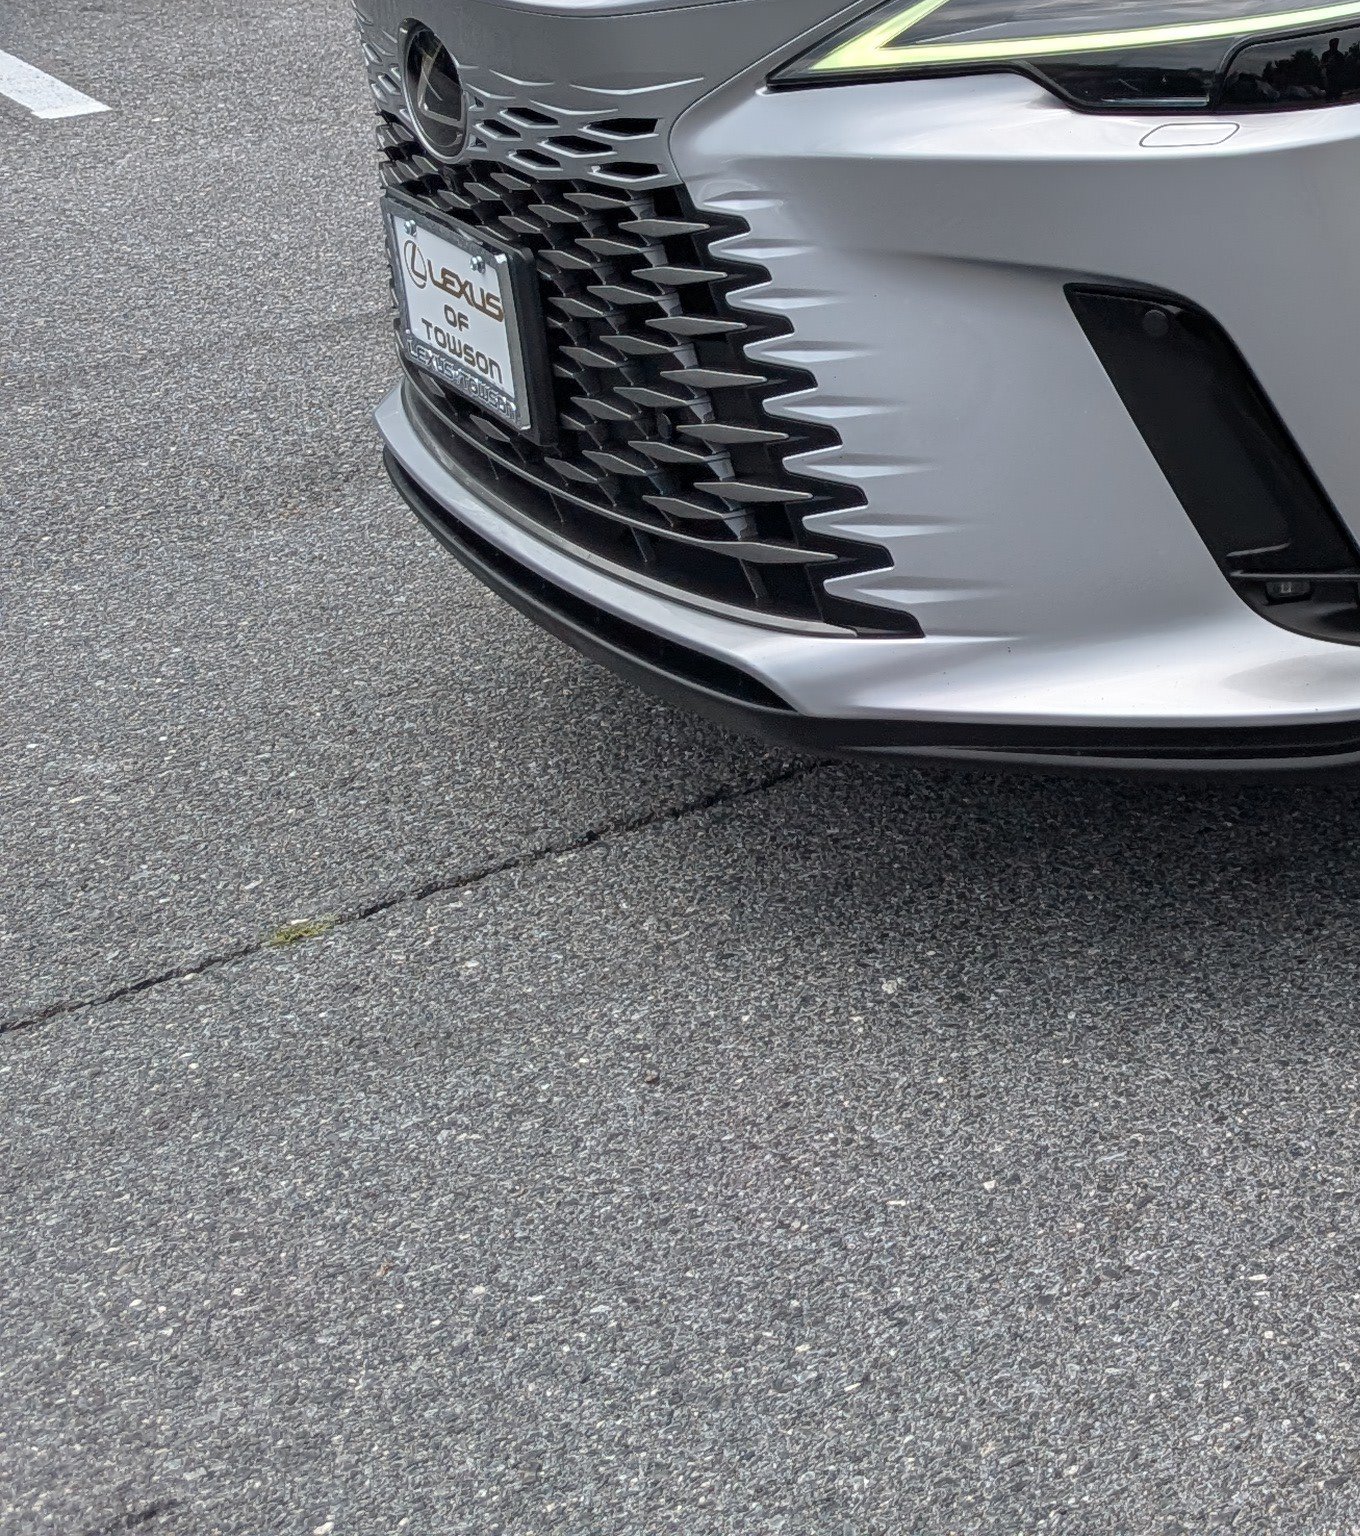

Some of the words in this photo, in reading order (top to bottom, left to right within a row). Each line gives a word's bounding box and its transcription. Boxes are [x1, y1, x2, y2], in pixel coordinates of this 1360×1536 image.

[427, 258, 504, 323] LEXUS
[443, 304, 469, 332] OF
[421, 318, 504, 385] TOWSON
